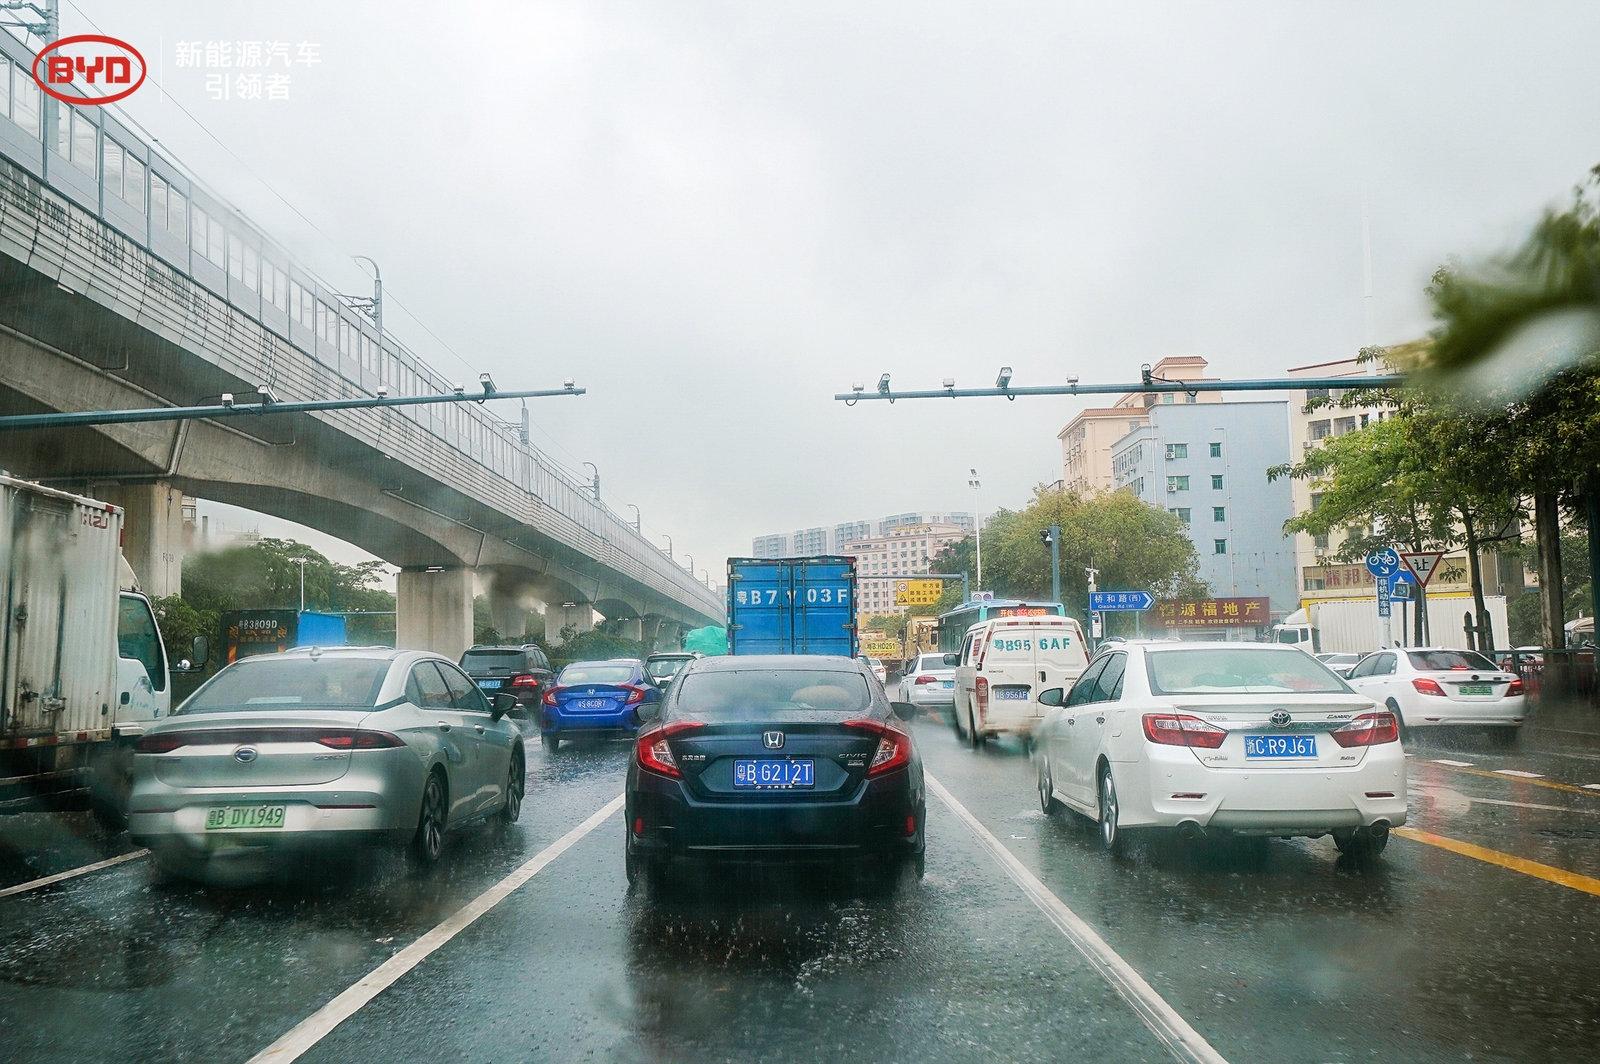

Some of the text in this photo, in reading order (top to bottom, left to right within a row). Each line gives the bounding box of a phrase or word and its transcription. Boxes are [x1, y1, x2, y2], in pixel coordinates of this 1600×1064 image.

[1413, 558, 1430, 572] 让
[1378, 577, 1390, 616] 非机动车道
